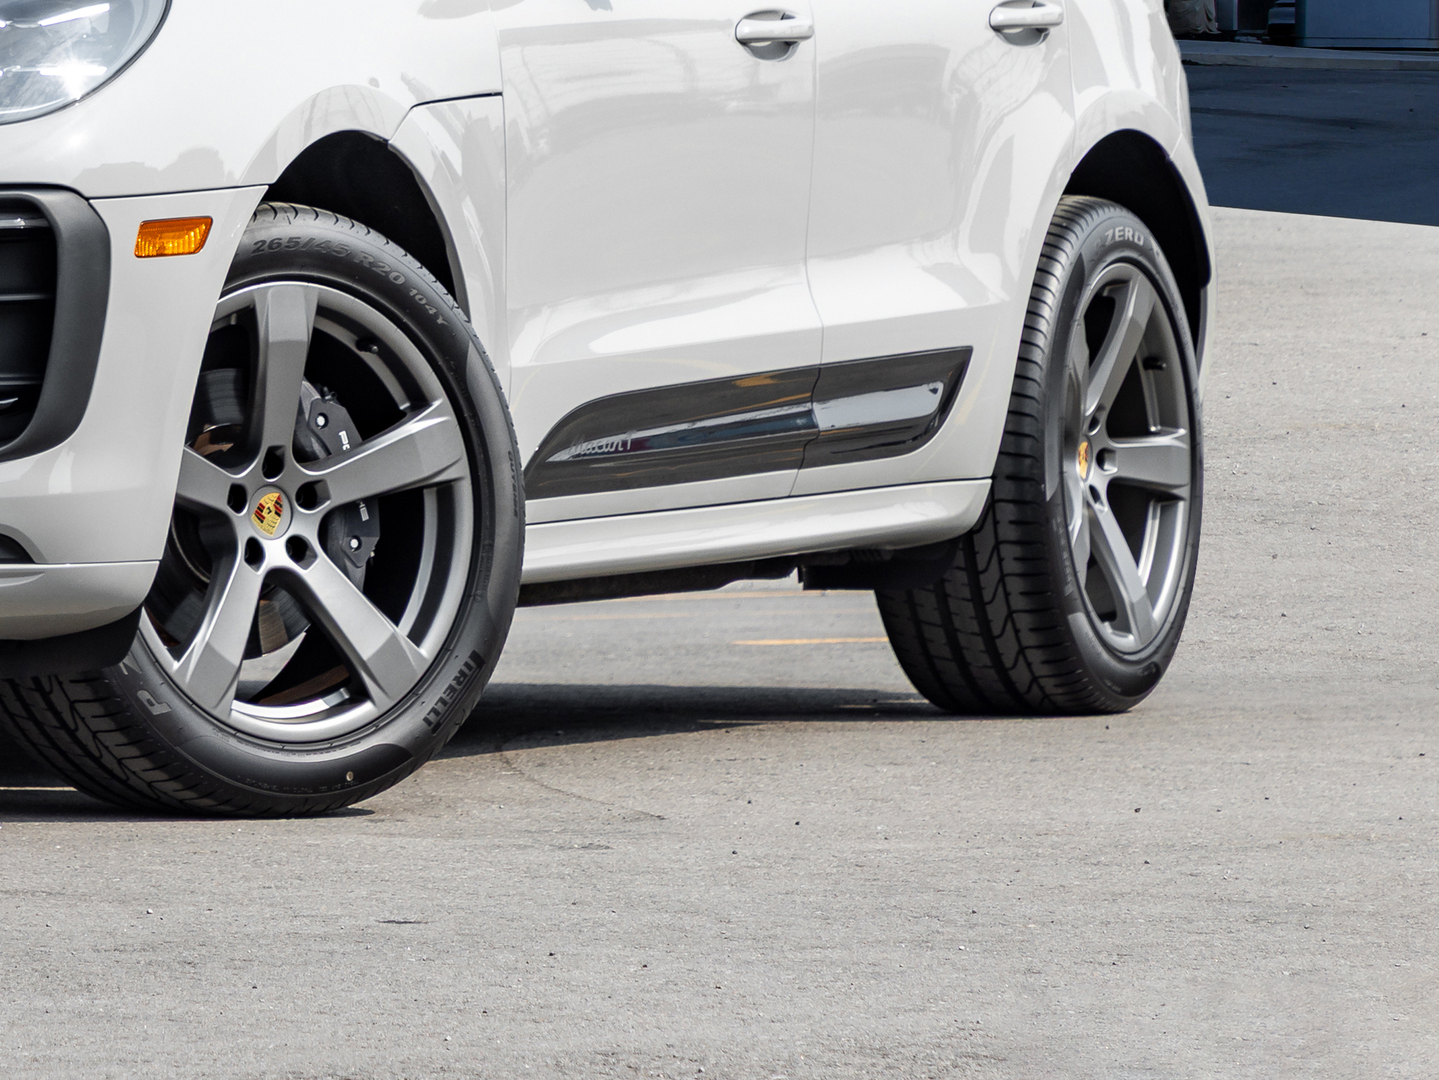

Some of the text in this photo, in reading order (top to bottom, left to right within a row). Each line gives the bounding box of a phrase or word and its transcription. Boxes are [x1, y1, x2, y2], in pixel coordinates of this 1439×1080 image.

[250, 236, 449, 326] 265/45 R20 104Y
[422, 649, 486, 734] PIRELLI
